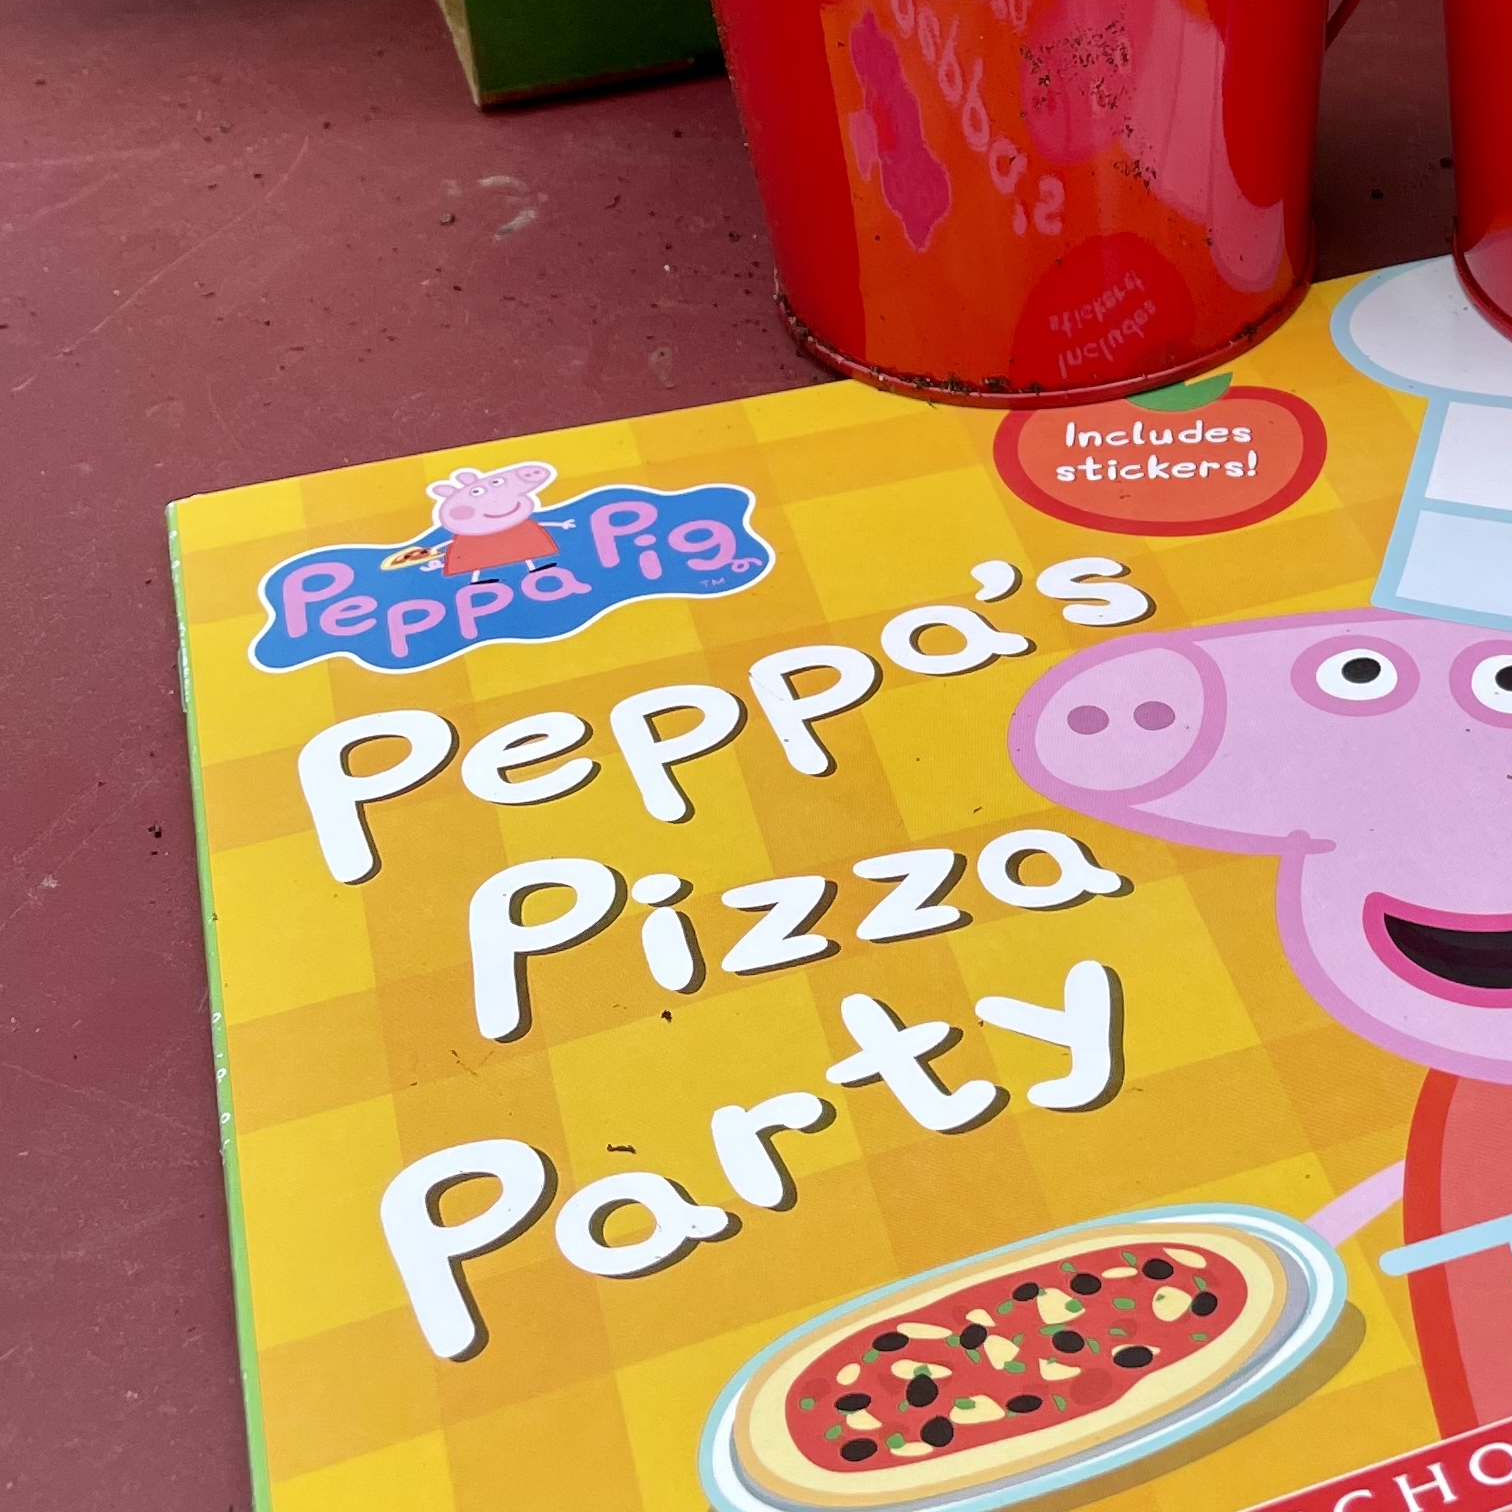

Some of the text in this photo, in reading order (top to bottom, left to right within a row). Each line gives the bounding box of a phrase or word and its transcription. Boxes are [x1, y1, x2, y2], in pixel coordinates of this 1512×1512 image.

[1055, 449, 1258, 482] stickers!
[1065, 419, 1252, 447] Includes
[282, 561, 593, 658] Peppa
[590, 500, 763, 580] Pig
[297, 555, 1156, 883] Peppa's
[467, 827, 1134, 1041] Pizza
[379, 958, 1126, 1360] Party
